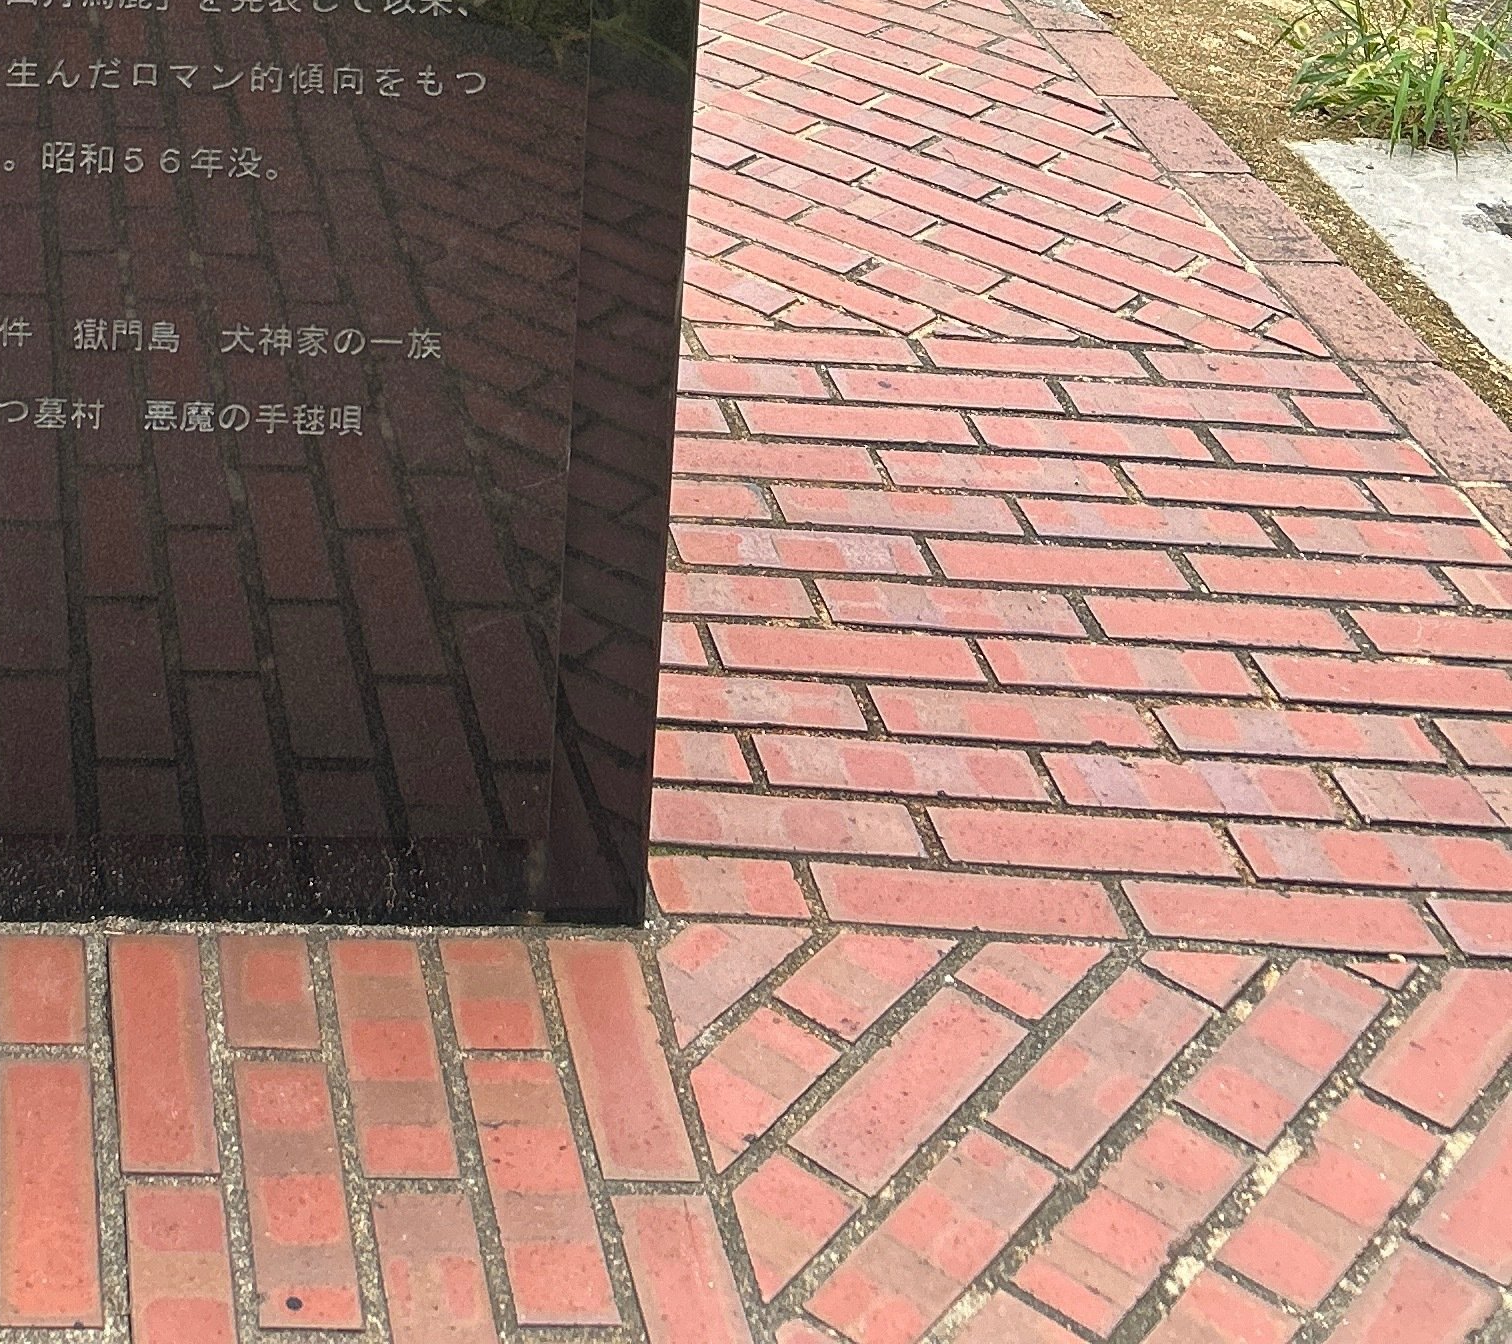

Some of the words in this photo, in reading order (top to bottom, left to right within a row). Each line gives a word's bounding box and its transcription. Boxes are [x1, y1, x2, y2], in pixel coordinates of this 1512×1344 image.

[73, 317, 181, 354] 獄門島
[220, 324, 444, 360] 犬神家の一族
[143, 398, 364, 437] 悪魔の手毬唄
